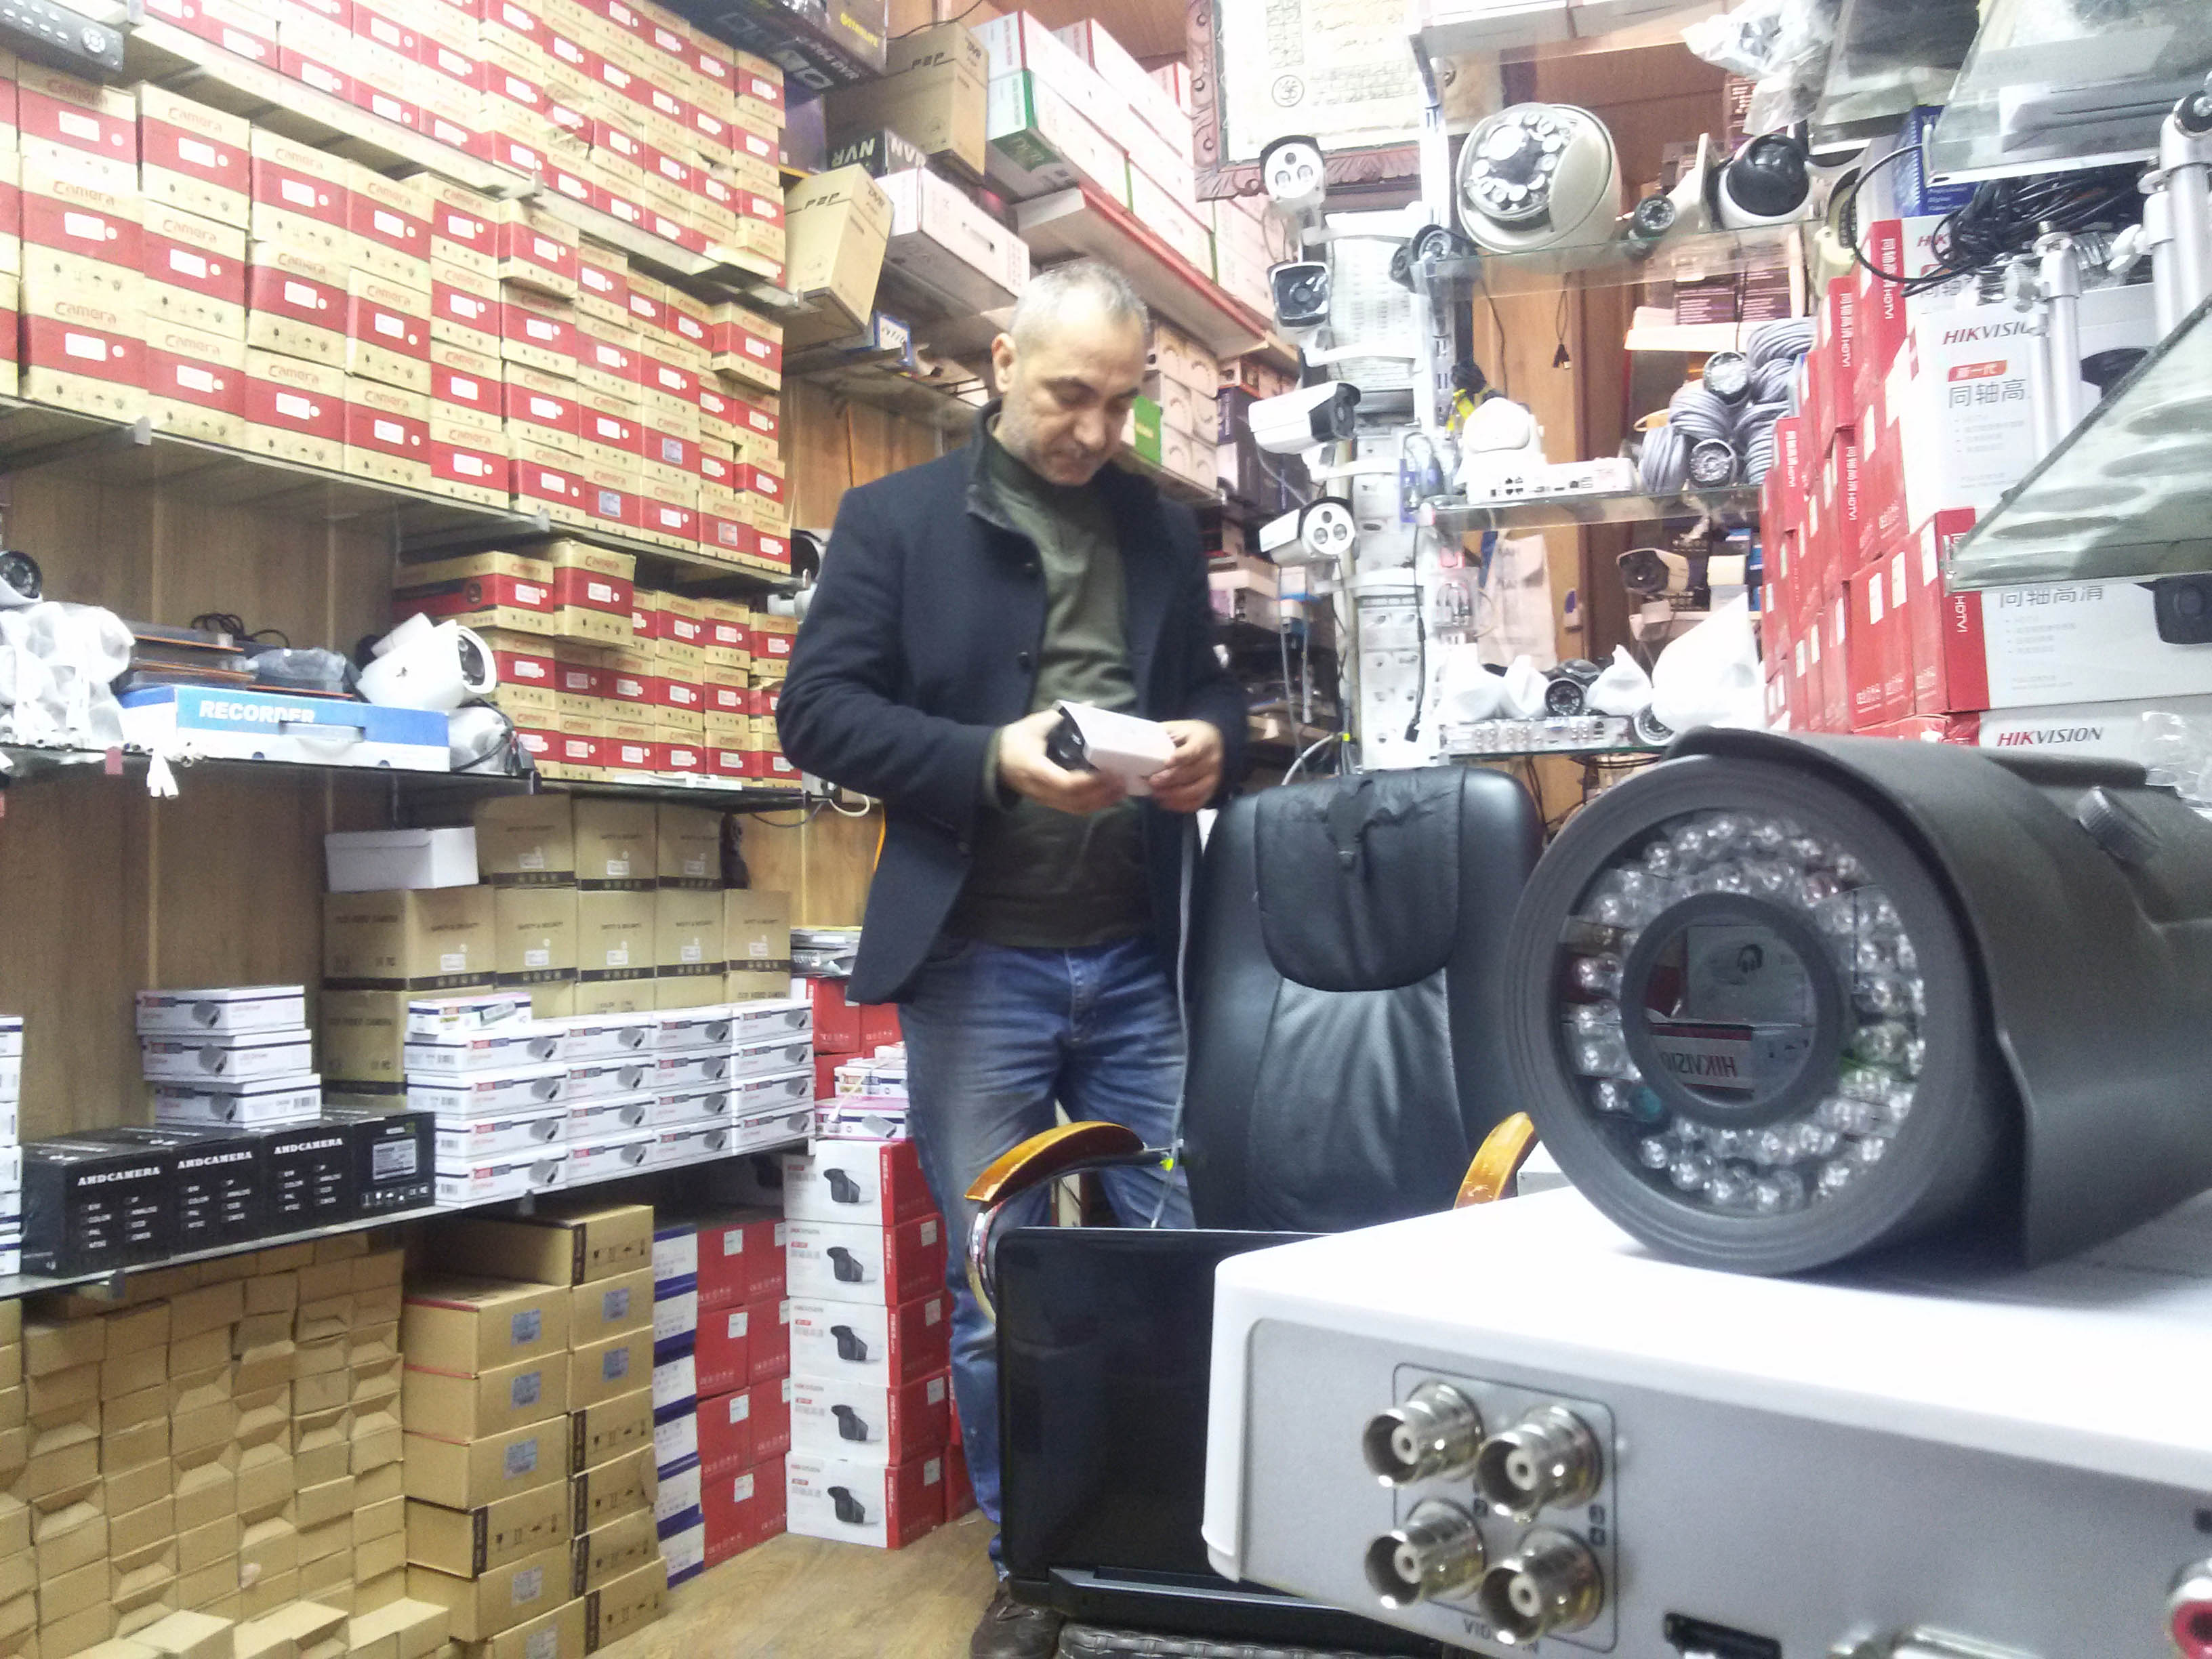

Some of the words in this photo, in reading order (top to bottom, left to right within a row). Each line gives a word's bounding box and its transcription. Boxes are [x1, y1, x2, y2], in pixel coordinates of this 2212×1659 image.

[169, 106, 222, 133] Camera
[275, 147, 324, 170] Camera
[52, 181, 115, 206] Camera
[163, 219, 217, 244] Camera
[277, 252, 326, 274] Camera
[367, 285, 411, 308] Camera
[54, 302, 117, 325] Camera
[165, 333, 220, 355] Camera
[268, 364, 320, 384] Camera
[364, 390, 409, 408] Camera
[1949, 379, 2027, 408] 同轴高
[199, 700, 315, 723] RECORDER
[1997, 727, 2104, 746] HIKVISION
